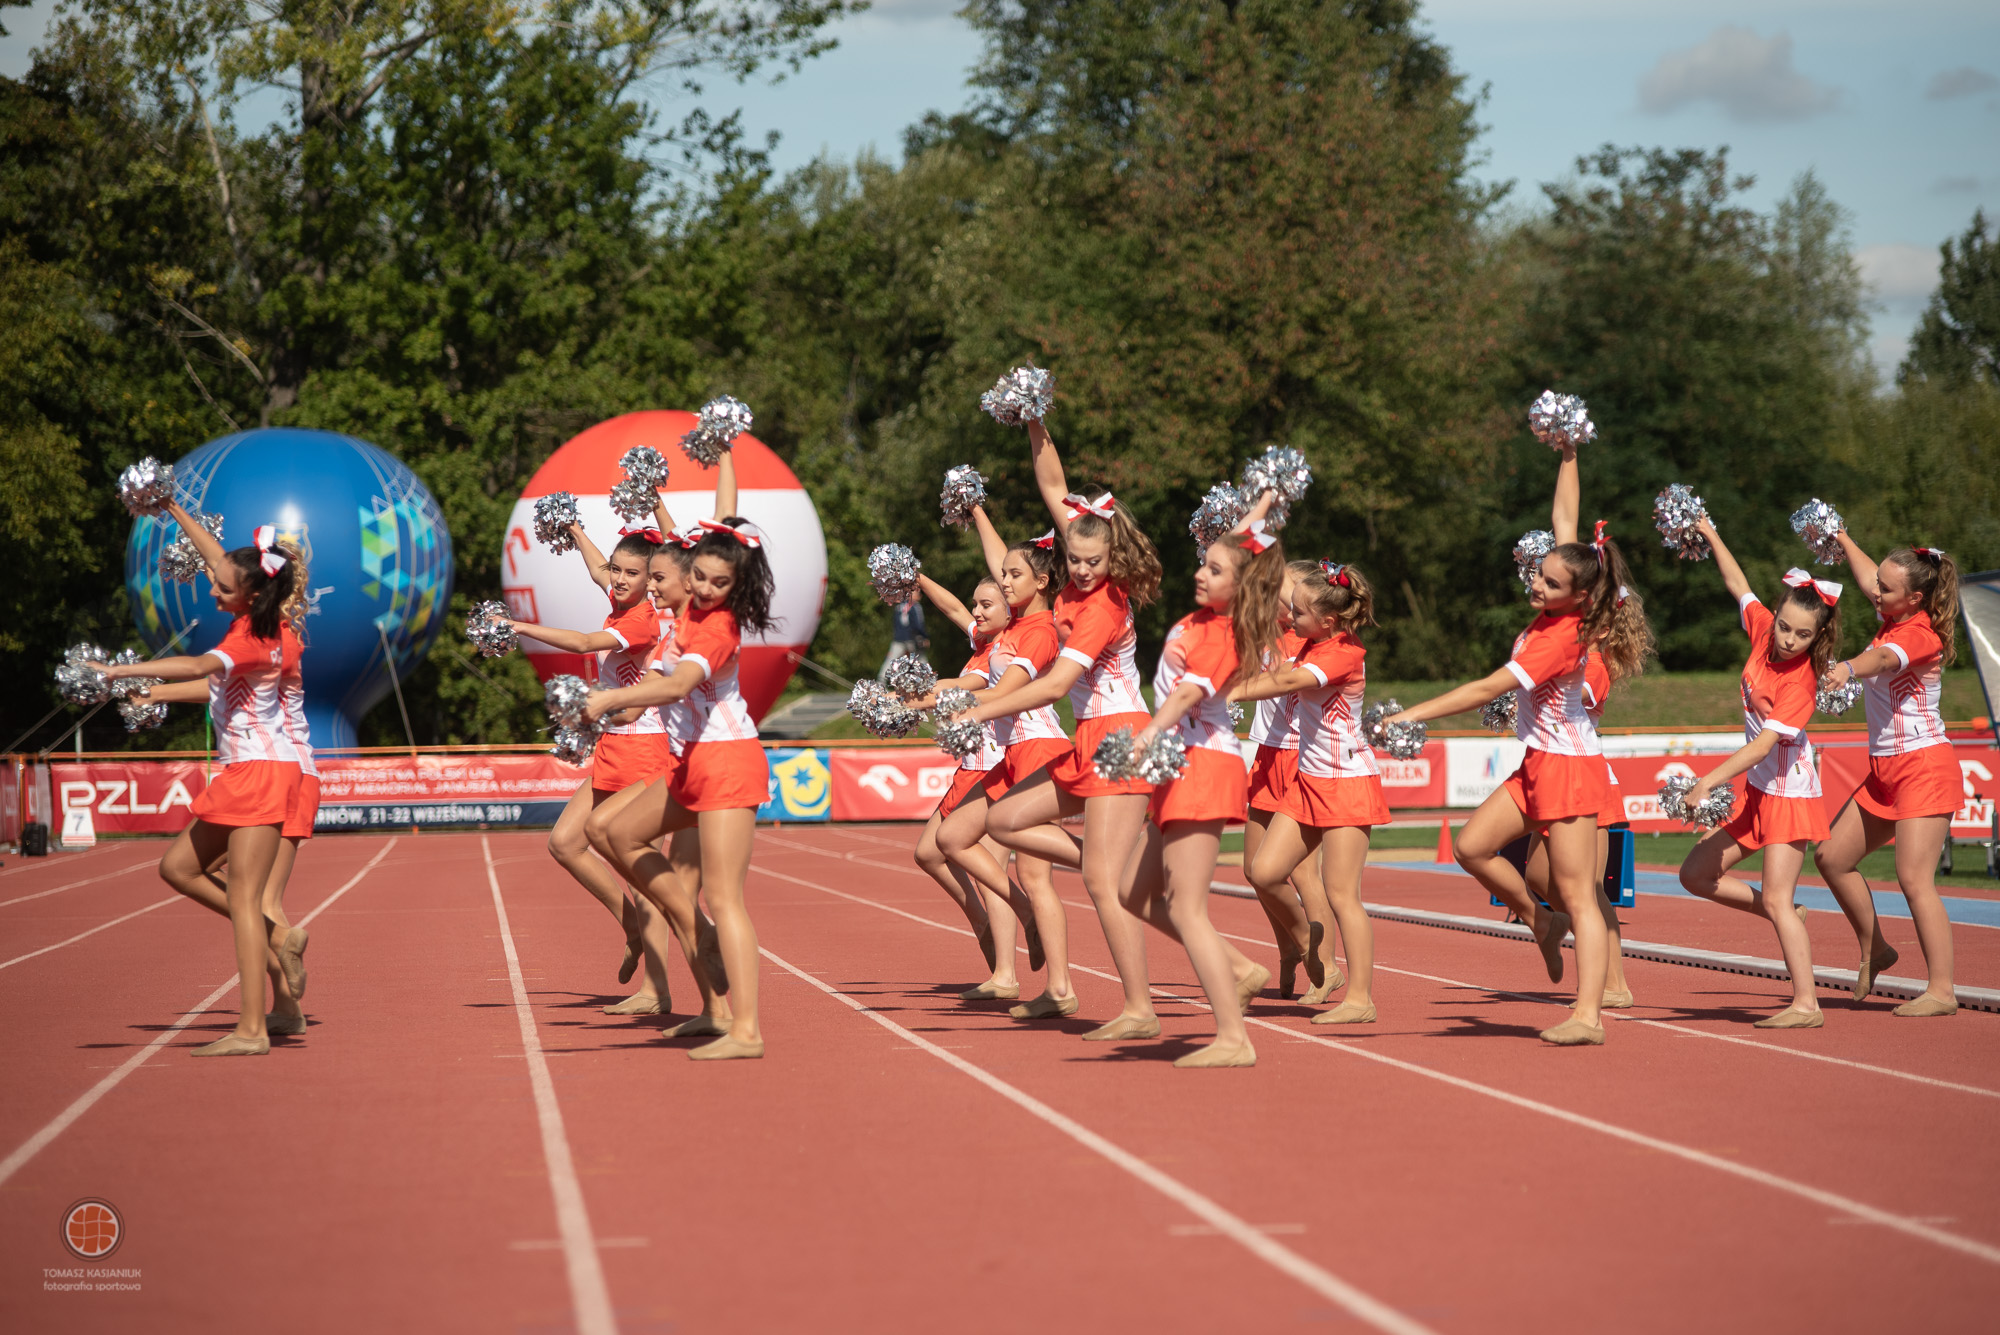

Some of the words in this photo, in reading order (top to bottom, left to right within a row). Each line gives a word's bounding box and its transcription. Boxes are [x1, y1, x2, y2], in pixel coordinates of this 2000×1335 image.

[60, 779, 194, 815] PZLA
[72, 814, 84, 832] 7
[314, 805, 368, 825] RNÓW,
[369, 807, 411, 823] 21-22
[412, 802, 485, 823] WRZEŚNIA
[486, 804, 522, 821] 2019
